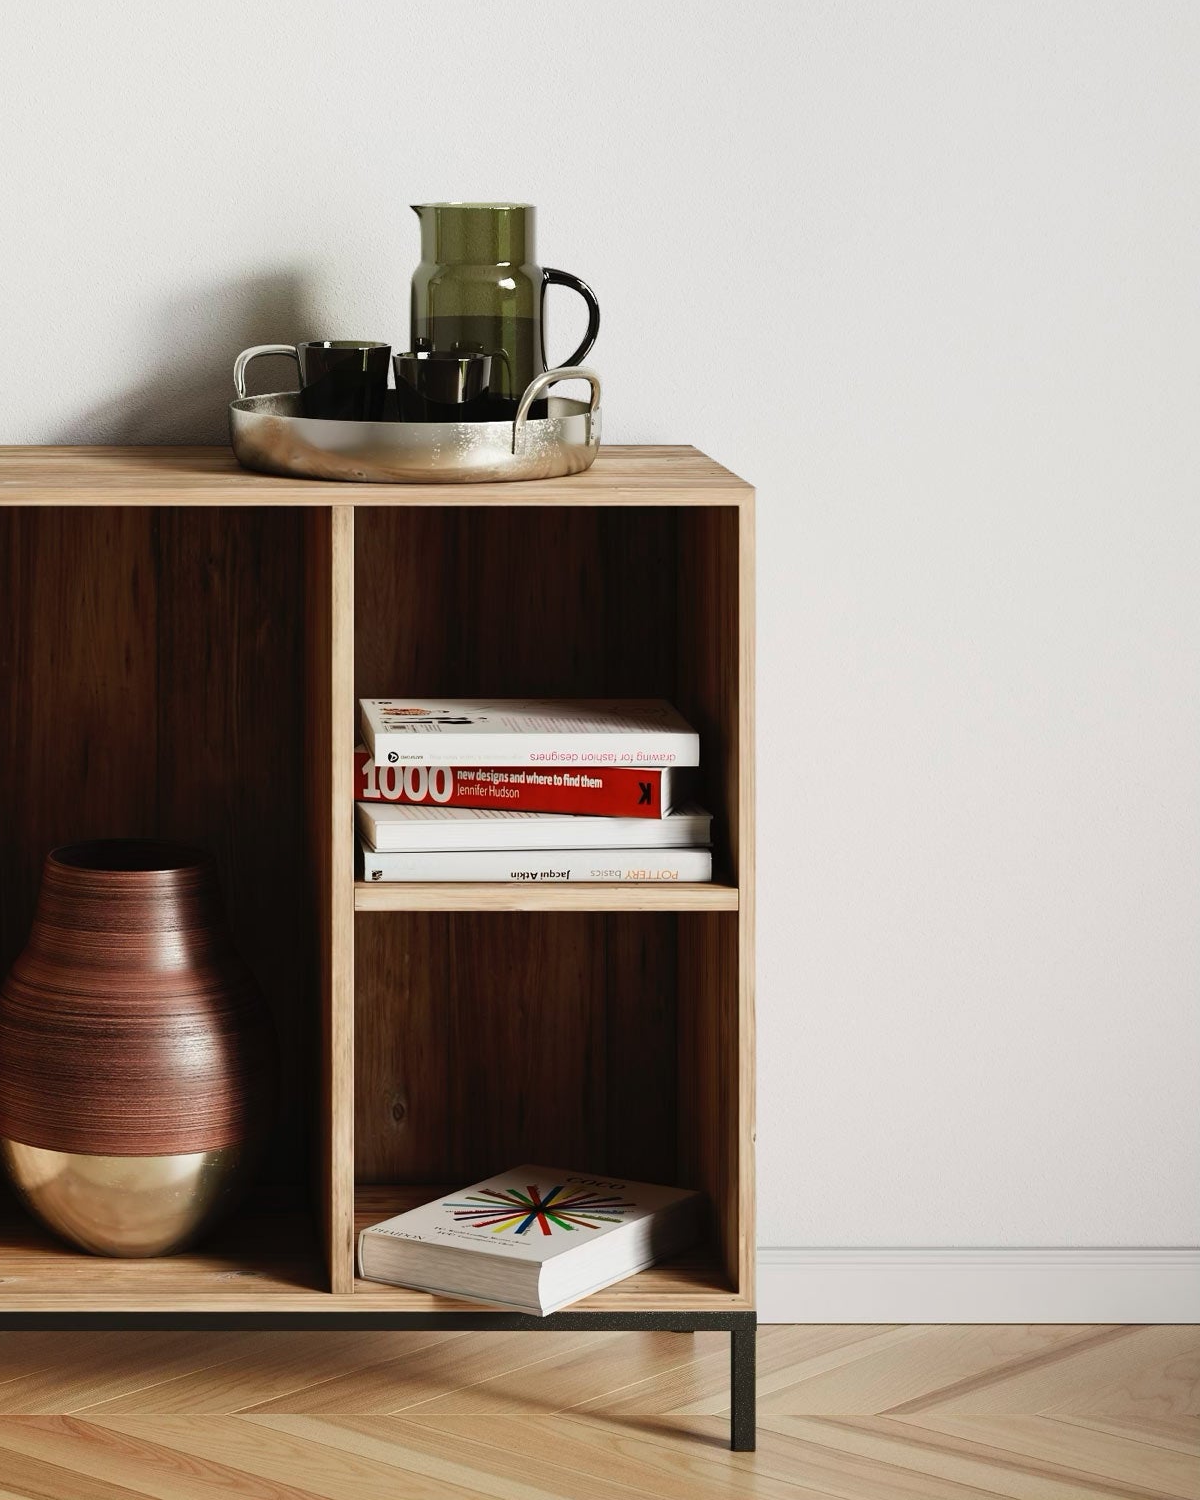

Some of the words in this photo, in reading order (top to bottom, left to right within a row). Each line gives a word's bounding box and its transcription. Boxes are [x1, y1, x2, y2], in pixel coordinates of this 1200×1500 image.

[529, 750, 578, 762] designers
[580, 752, 617, 763] fashion
[619, 752, 633, 763] for
[635, 751, 676, 762] drawing
[361, 762, 454, 803] 1000
[456, 769, 475, 781] new
[475, 769, 509, 784] designs
[509, 770, 525, 783] and
[525, 772, 553, 786] where
[553, 775, 563, 787] to
[563, 774, 580, 787] find
[580, 775, 603, 789] them
[456, 780, 488, 797] Jennifer
[488, 783, 520, 799] Hudson
[509, 870, 537, 880] Atkin
[539, 869, 570, 880] Jacqui
[589, 868, 621, 879] basics
[624, 868, 678, 880] POTTERY
[566, 1175, 627, 1190] COCO
